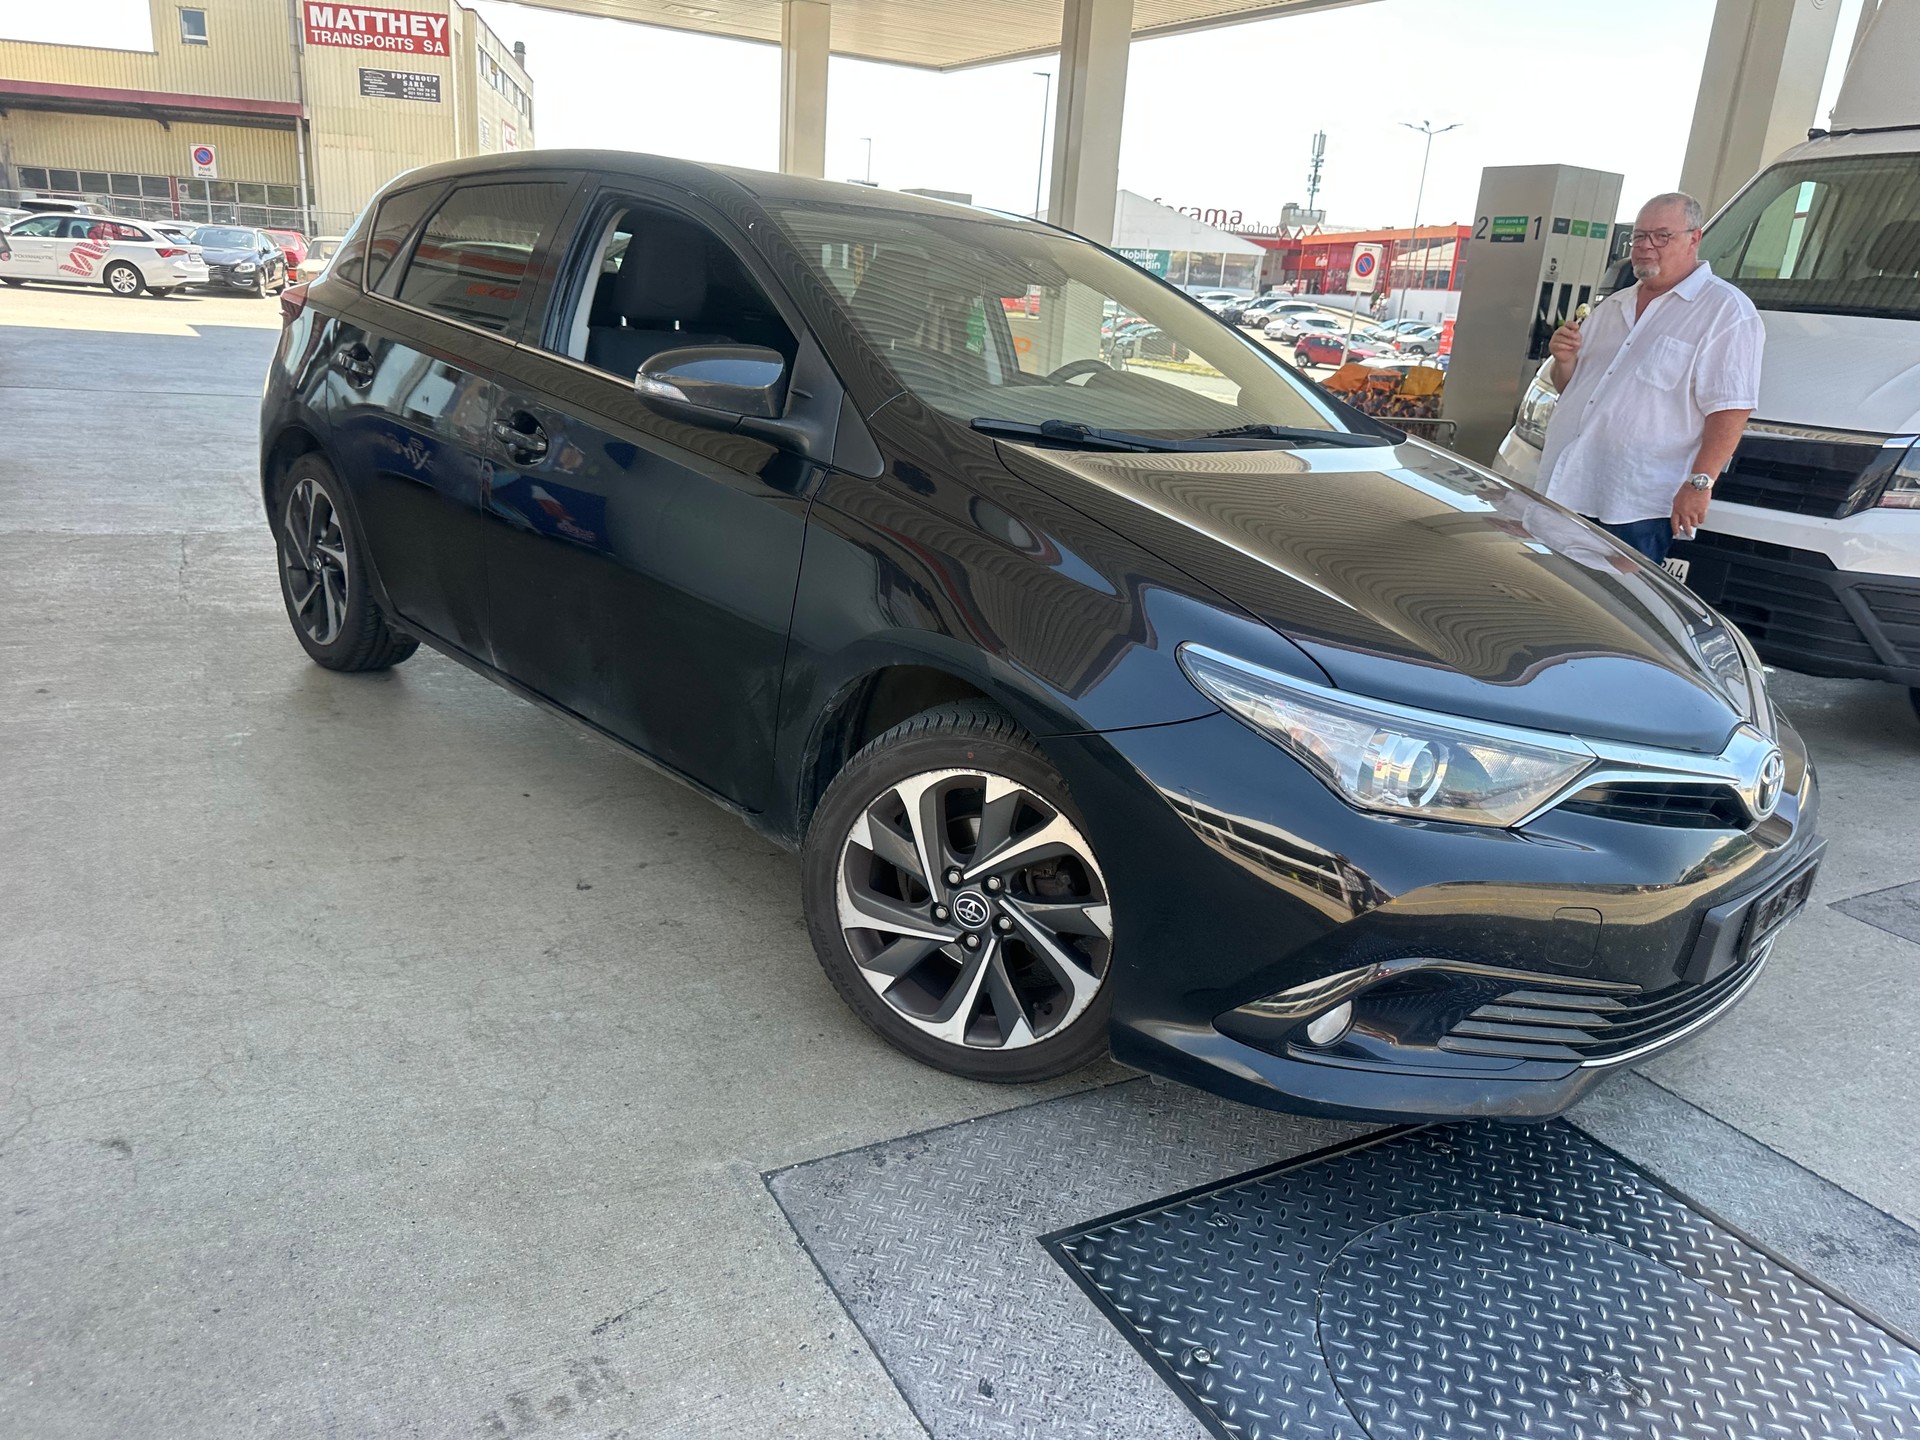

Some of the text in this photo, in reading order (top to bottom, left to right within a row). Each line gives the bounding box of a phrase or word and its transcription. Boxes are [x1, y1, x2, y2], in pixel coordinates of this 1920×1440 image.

[309, 5, 446, 38] MATTHEY
[311, 29, 445, 54] TRANSPORTS SA
[403, 80, 425, 88] SARL
[409, 75, 438, 83] GROUP
[1475, 216, 1543, 240] 2 1
[1120, 250, 1159, 260] Mobilier
